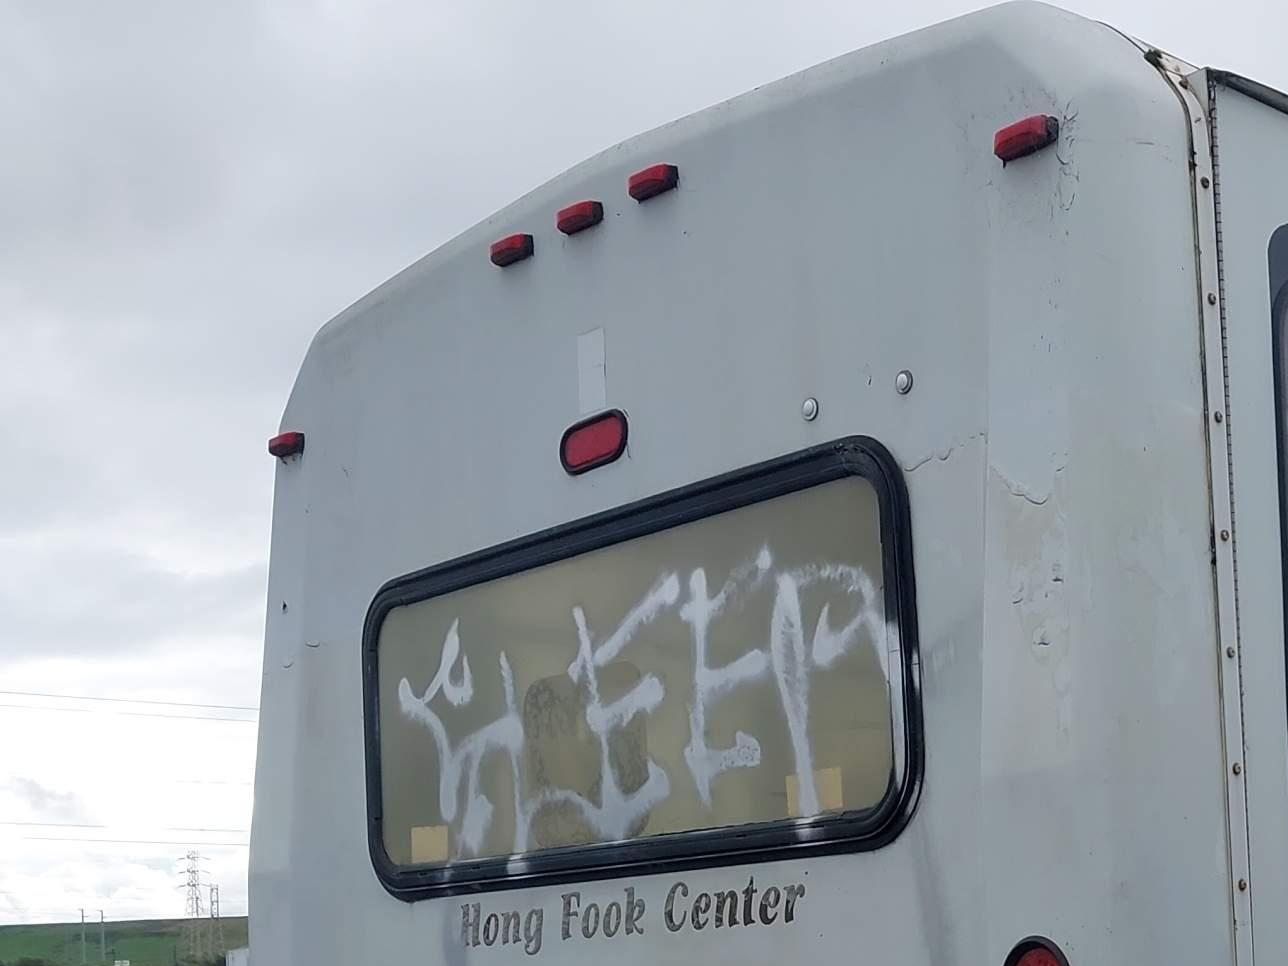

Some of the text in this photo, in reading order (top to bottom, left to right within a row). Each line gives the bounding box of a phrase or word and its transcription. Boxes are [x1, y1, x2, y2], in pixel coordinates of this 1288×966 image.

[460, 876, 806, 955] Hong Fook Center
